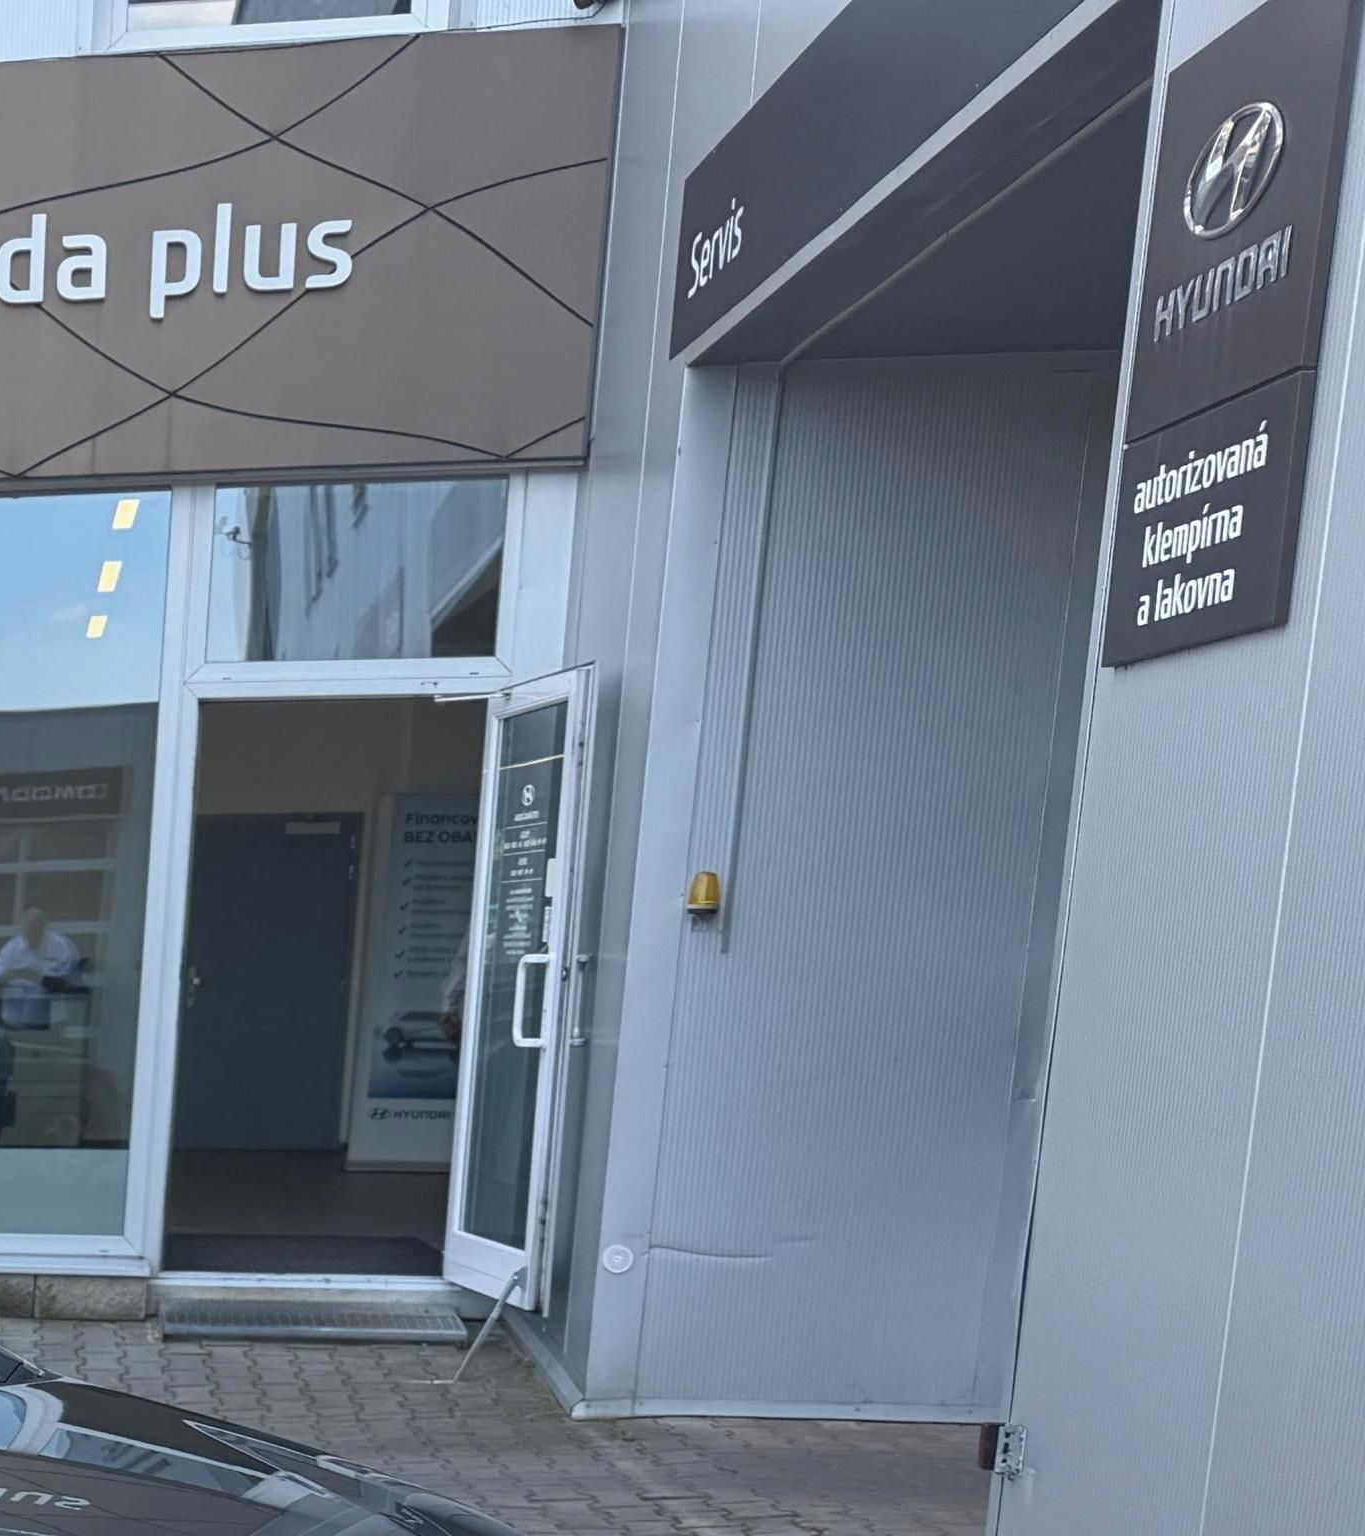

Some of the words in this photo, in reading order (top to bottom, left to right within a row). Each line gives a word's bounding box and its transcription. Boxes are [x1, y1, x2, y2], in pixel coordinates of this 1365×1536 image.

[149, 202, 354, 320] plus
[688, 197, 744, 300] Servis
[1153, 225, 1294, 343] HYUNDAI
[1133, 420, 1270, 515] autorizovaná
[1142, 502, 1243, 568] klempírna
[1137, 593, 1148, 626] a
[1154, 568, 1235, 624] lakovna
[403, 831, 435, 844] BEZ
[405, 812, 478, 825] Financov
[392, 1109, 451, 1120] HYUNDAI
